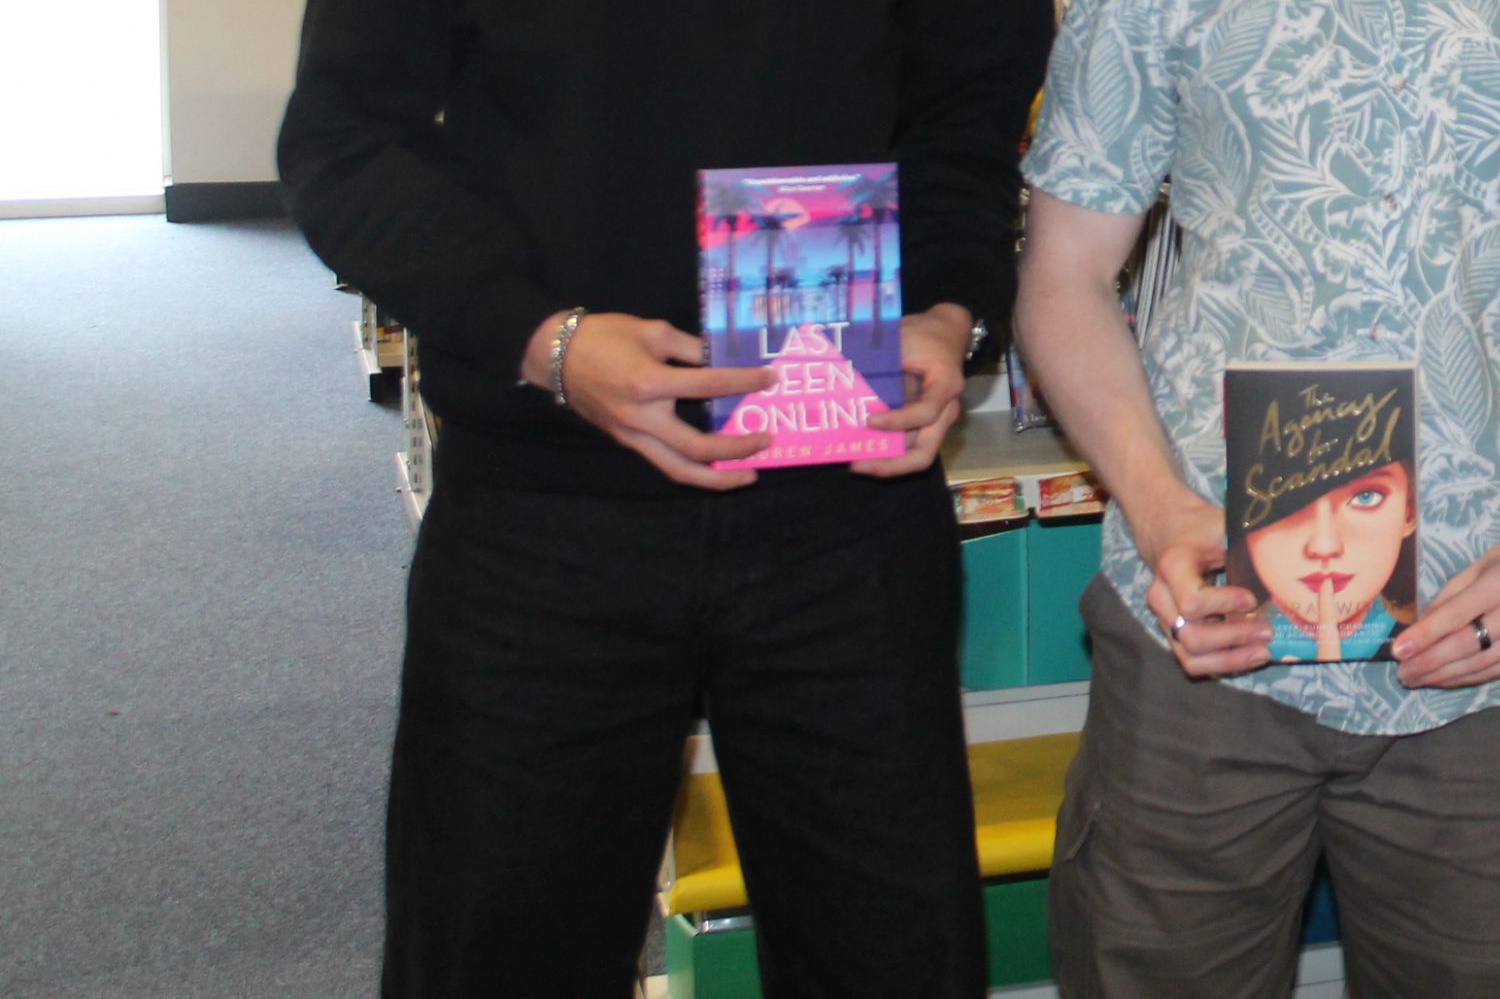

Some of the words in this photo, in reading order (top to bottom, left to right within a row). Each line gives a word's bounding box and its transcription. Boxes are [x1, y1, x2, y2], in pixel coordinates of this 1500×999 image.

[759, 322, 850, 359] LAST
[1299, 384, 1335, 408] The
[1257, 388, 1398, 458] Agency
[824, 439, 890, 456] JAMES
[1242, 407, 1401, 528] Scandal
